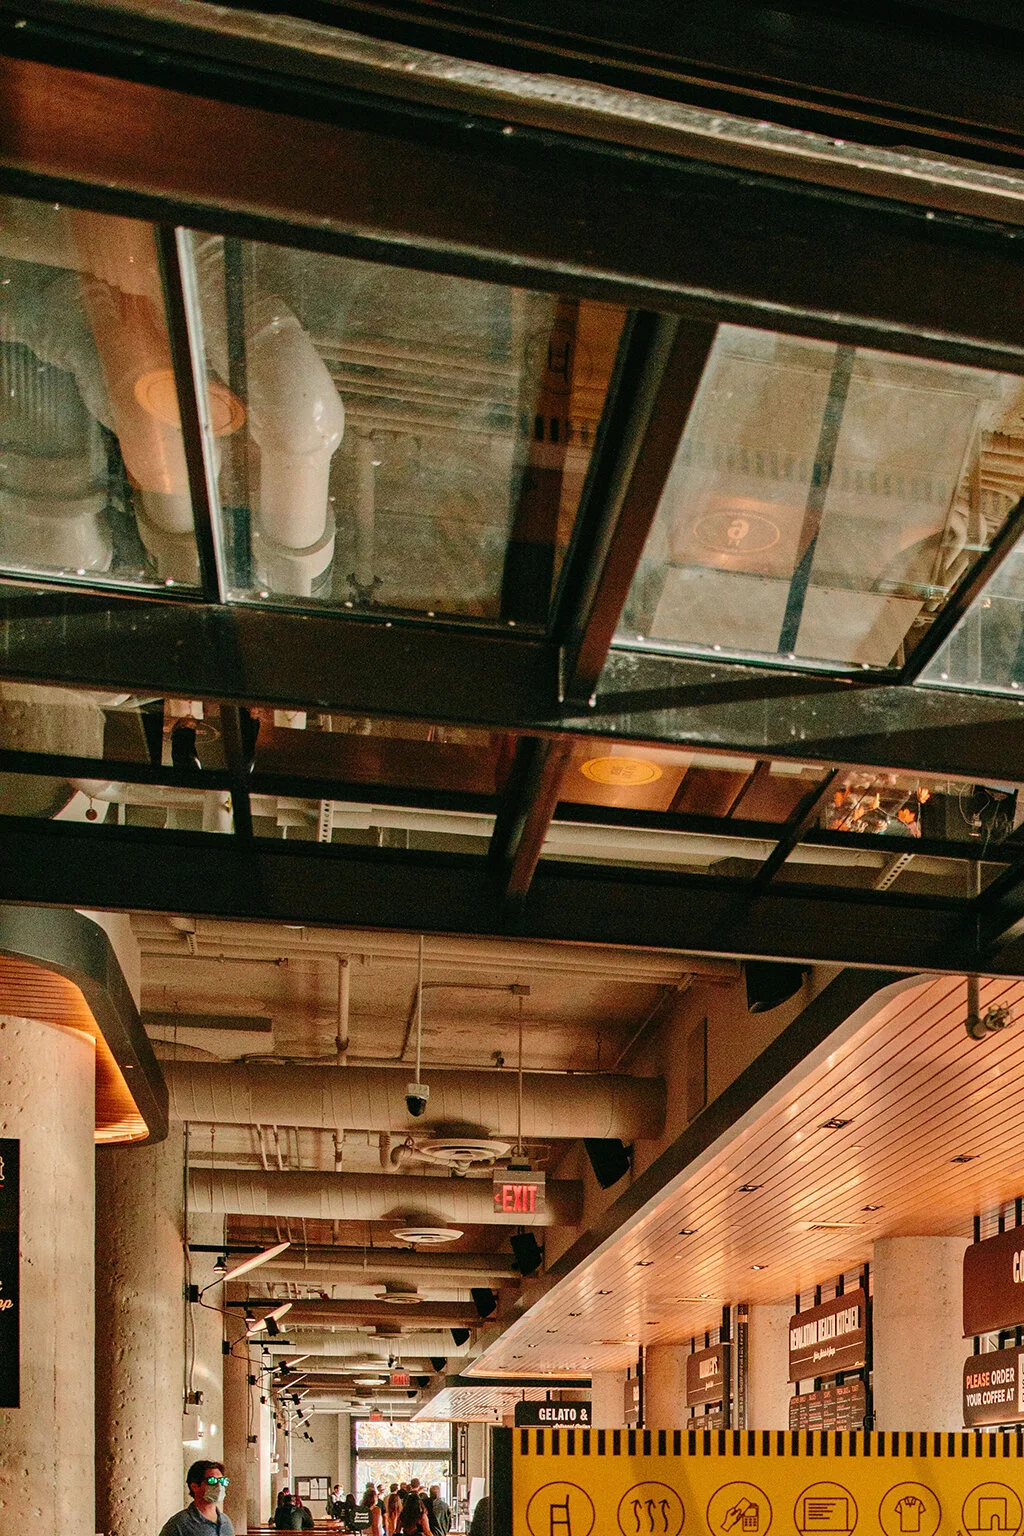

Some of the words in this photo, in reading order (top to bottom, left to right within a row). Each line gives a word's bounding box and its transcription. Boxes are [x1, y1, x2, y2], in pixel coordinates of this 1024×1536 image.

[502, 1184, 538, 1212] EXIT
[966, 1372, 990, 1389] PLEASE
[990, 1367, 1015, 1386] ORDER
[966, 1392, 982, 1407] YOUR
[982, 1389, 1006, 1404] COFFEE
[1006, 1388, 1015, 1401] AT
[538, 1408, 576, 1420] GELATO
[580, 1408, 588, 1420] &
